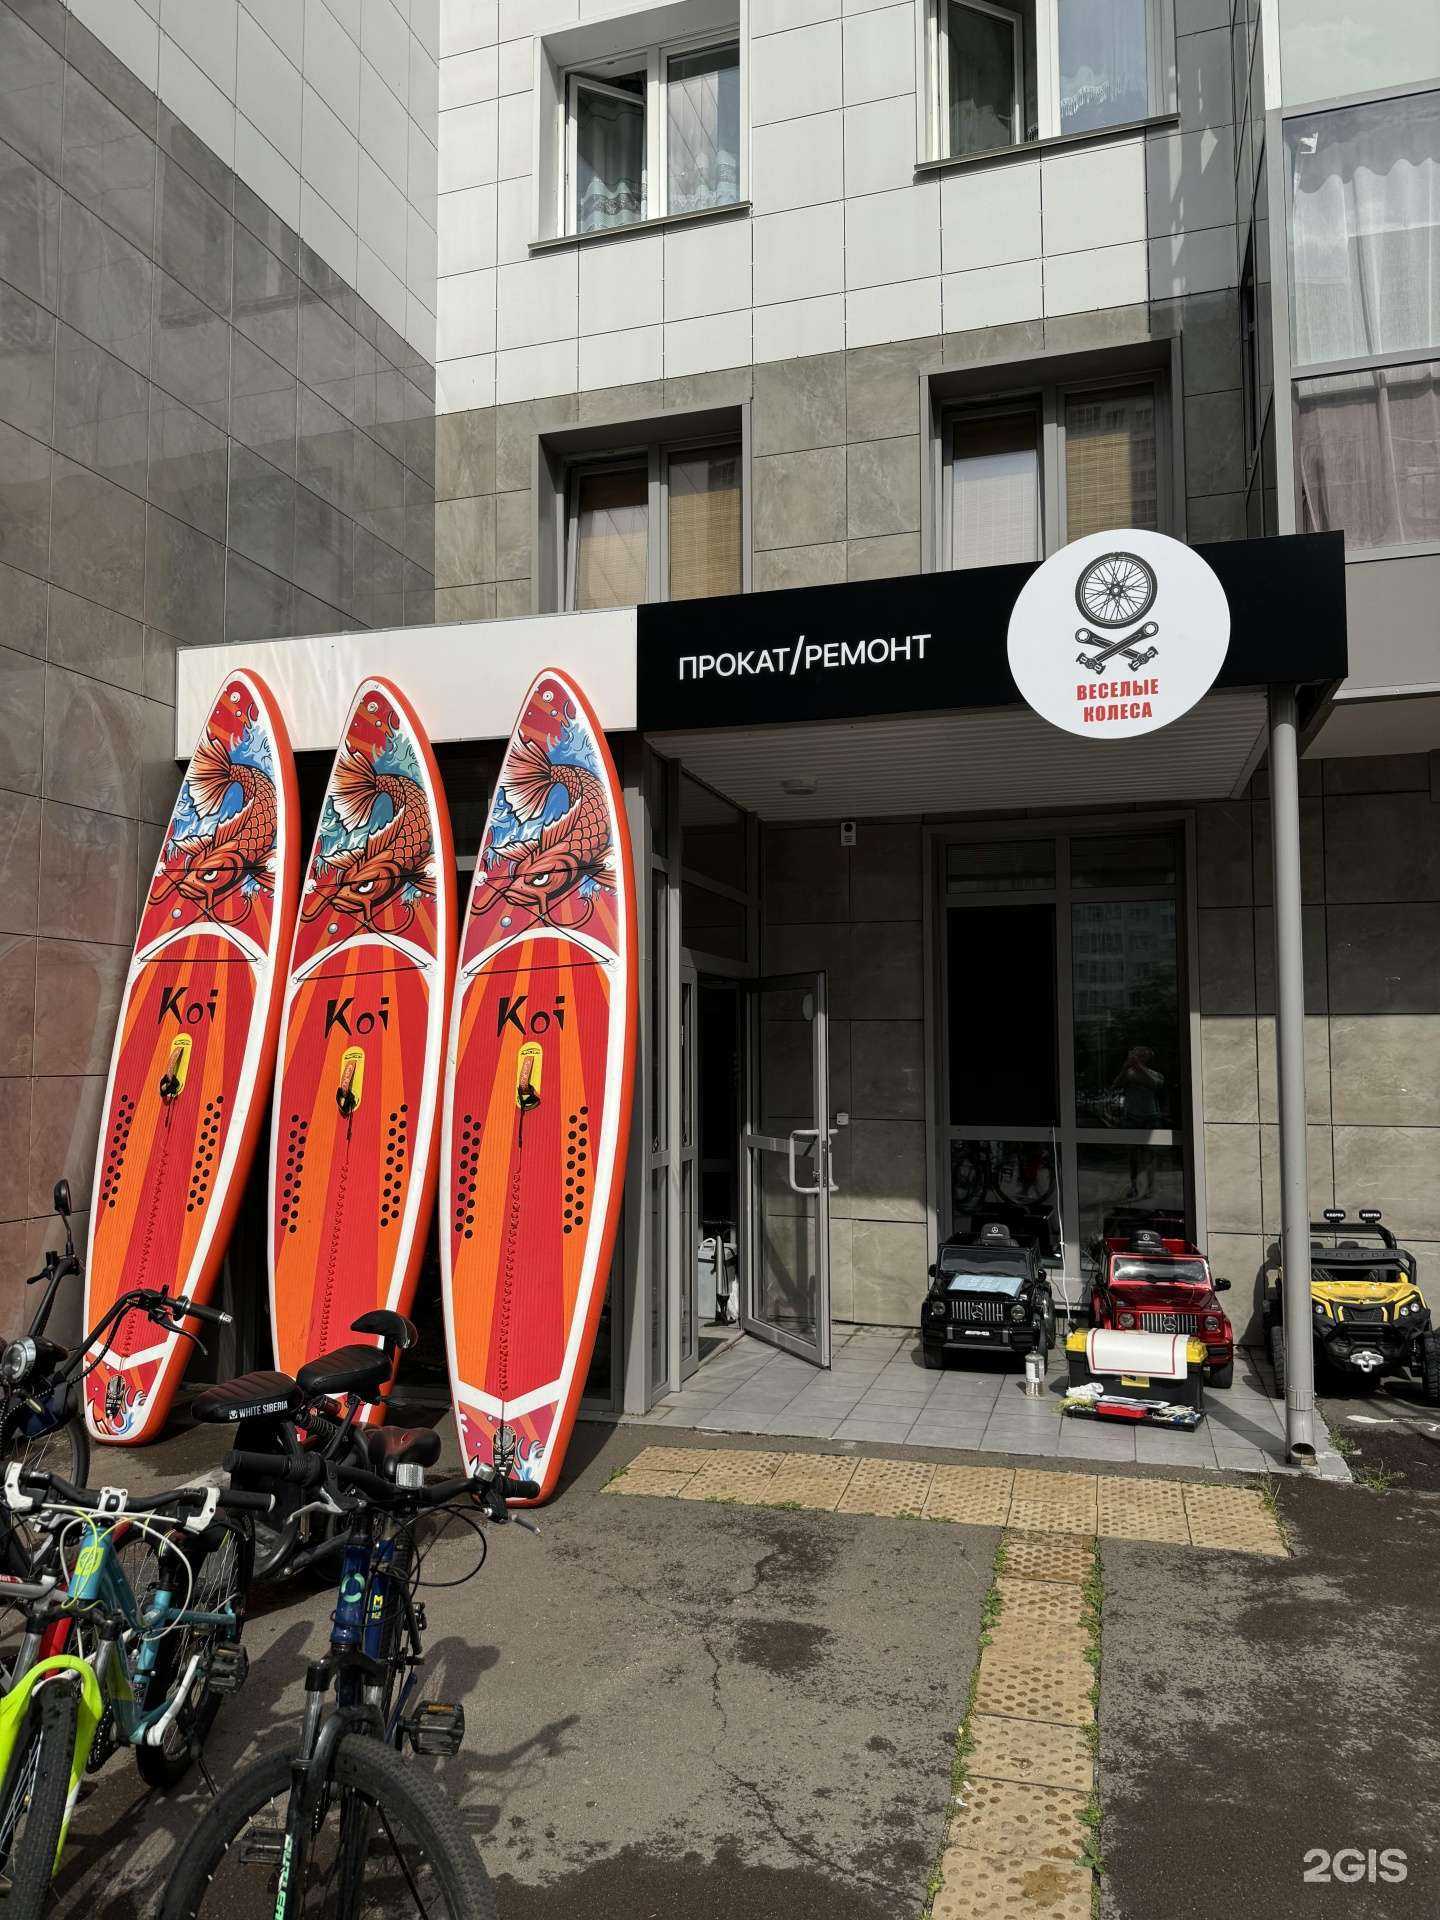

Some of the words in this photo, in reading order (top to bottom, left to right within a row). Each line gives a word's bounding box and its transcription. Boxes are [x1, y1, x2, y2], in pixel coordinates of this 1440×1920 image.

[679, 634, 931, 680] ПРОКАТ/РЕМОНТ
[1076, 678, 1159, 701] ВЕСЕЛЫЕ
[1083, 702, 1152, 722] КОЛЕСА
[158, 986, 219, 1025] Koi
[324, 997, 390, 1040] Koi
[496, 995, 566, 1038] Koi
[239, 1405, 261, 1418] WHITE
[262, 1400, 288, 1413] SIBERIA
